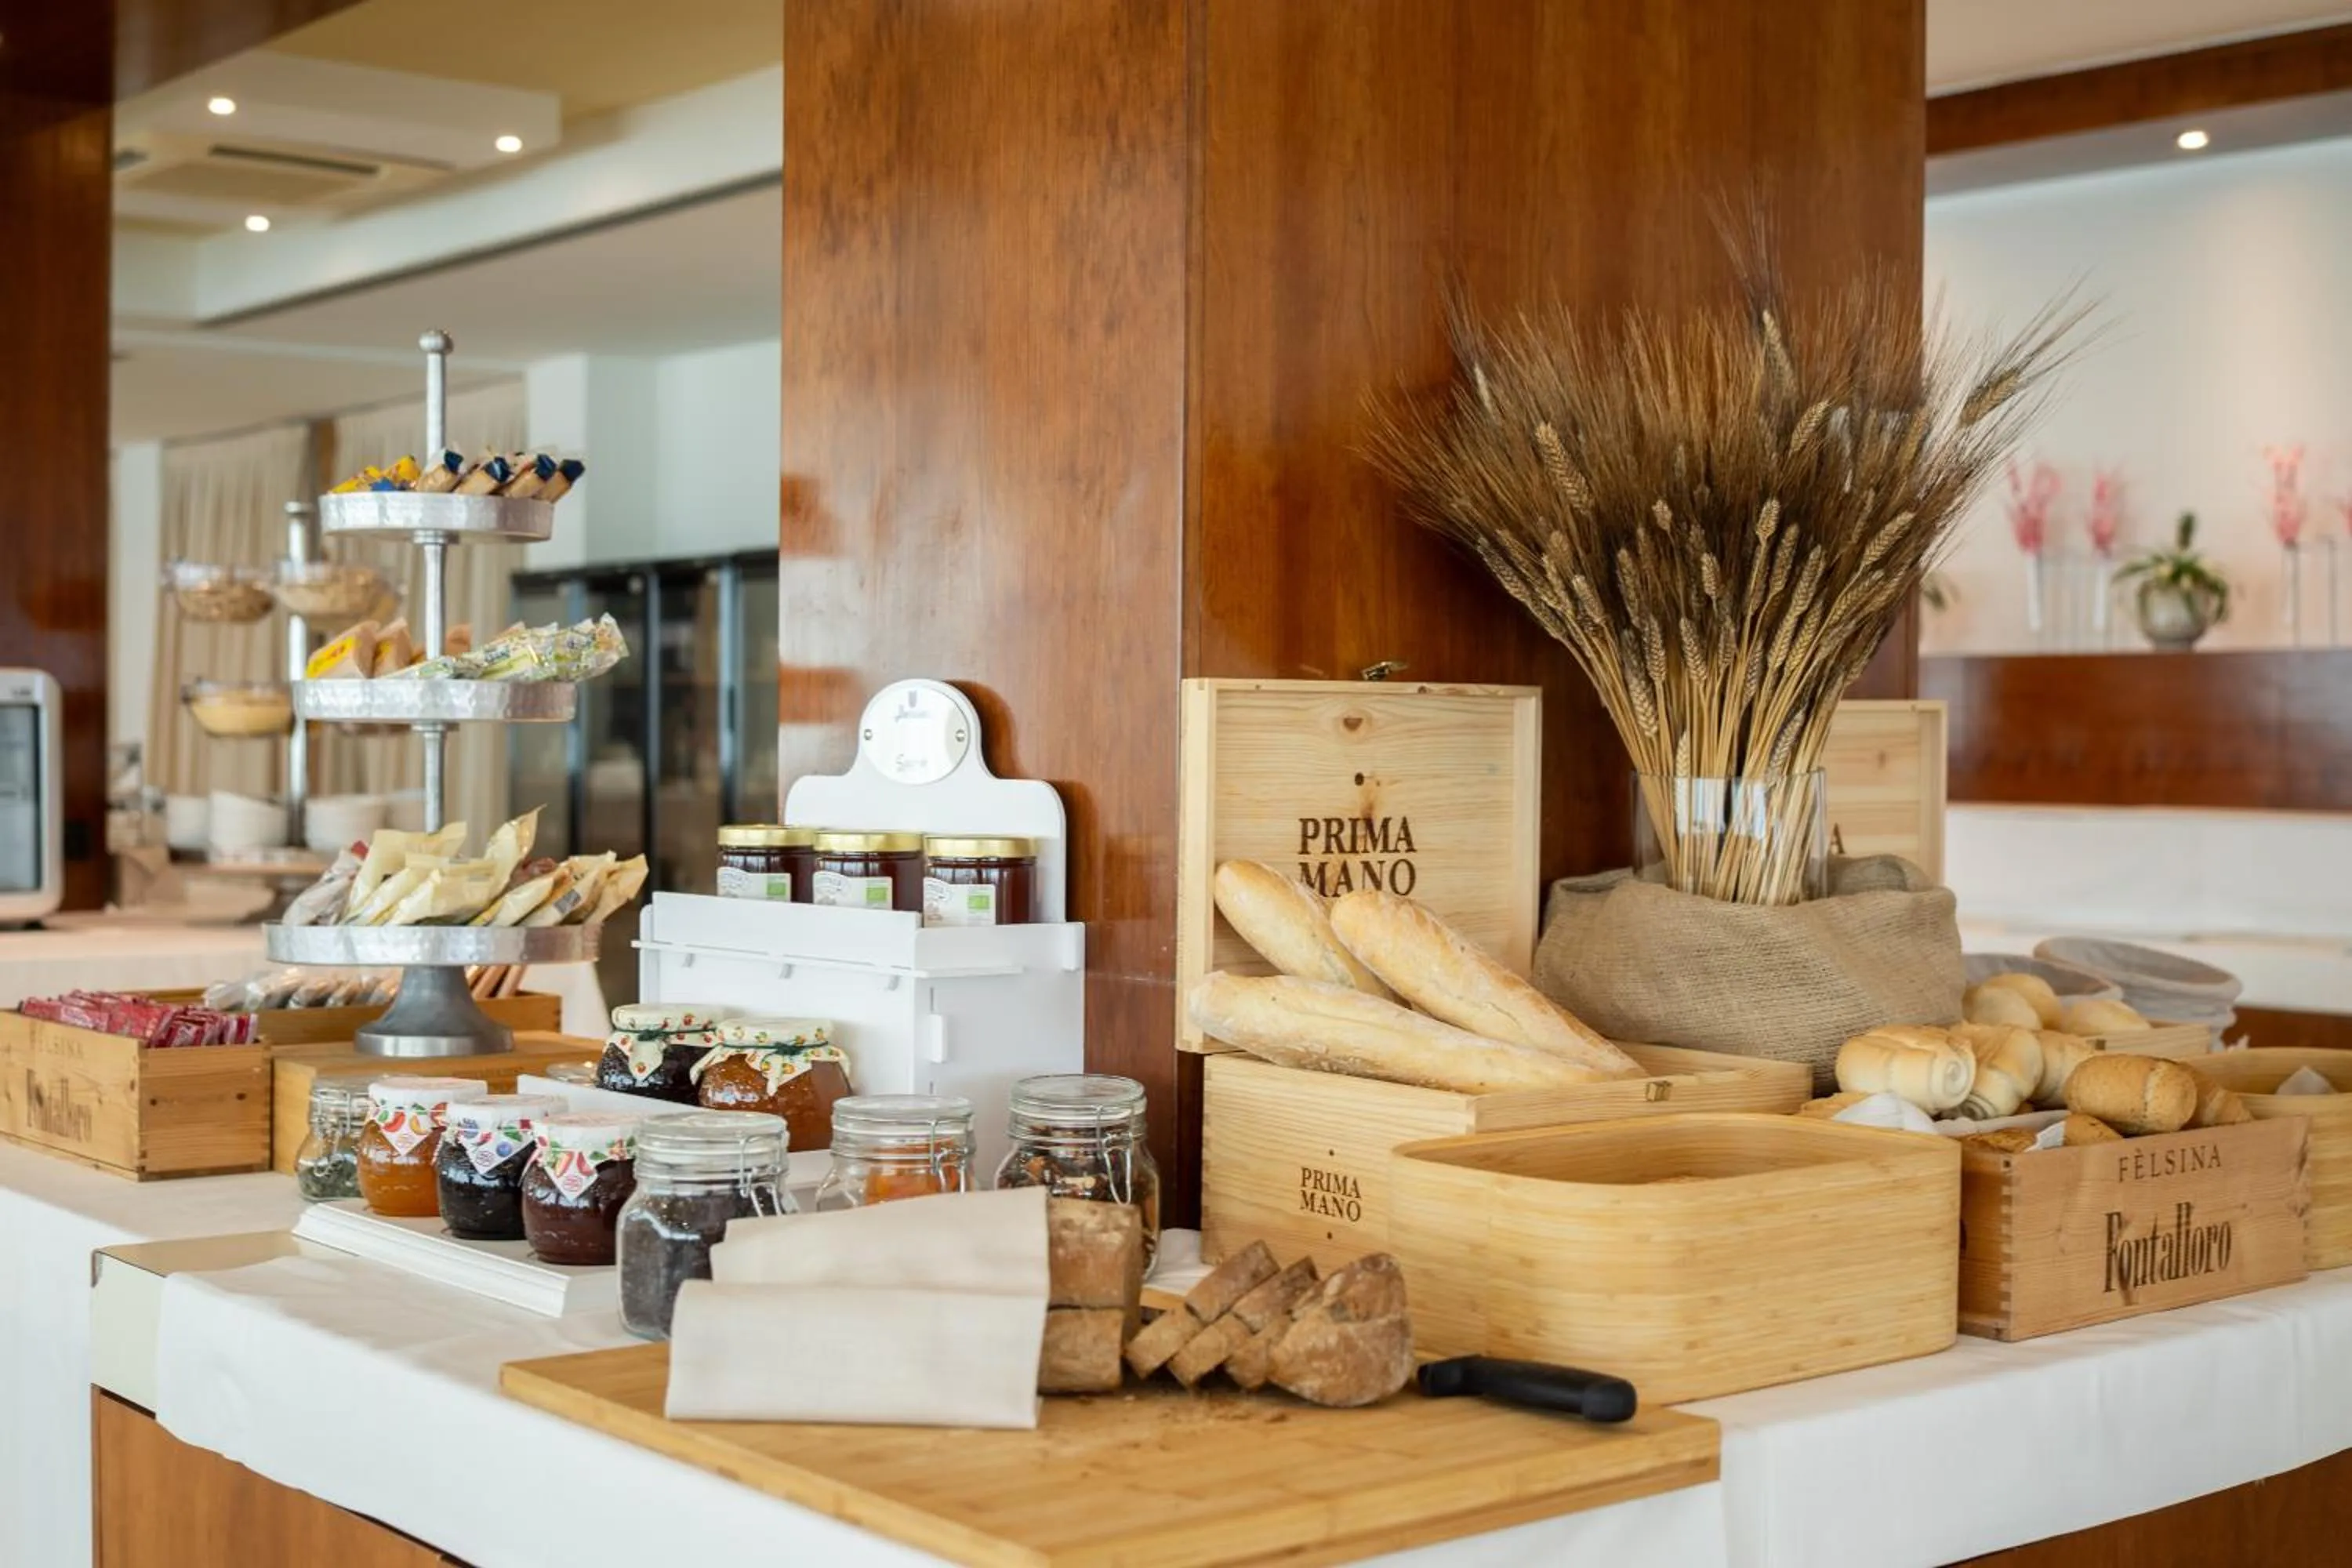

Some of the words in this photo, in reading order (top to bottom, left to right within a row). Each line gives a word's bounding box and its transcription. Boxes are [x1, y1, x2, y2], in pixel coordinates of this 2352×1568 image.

[1298, 815, 1417, 855] PRIMA
[1298, 858, 1416, 897] MANO
[1300, 1167, 1362, 1199] PRIMA
[2118, 1144, 2223, 1183] FÈLSINA
[1300, 1189, 1361, 1222] MANO
[2103, 1201, 2233, 1293] Fontalloro
